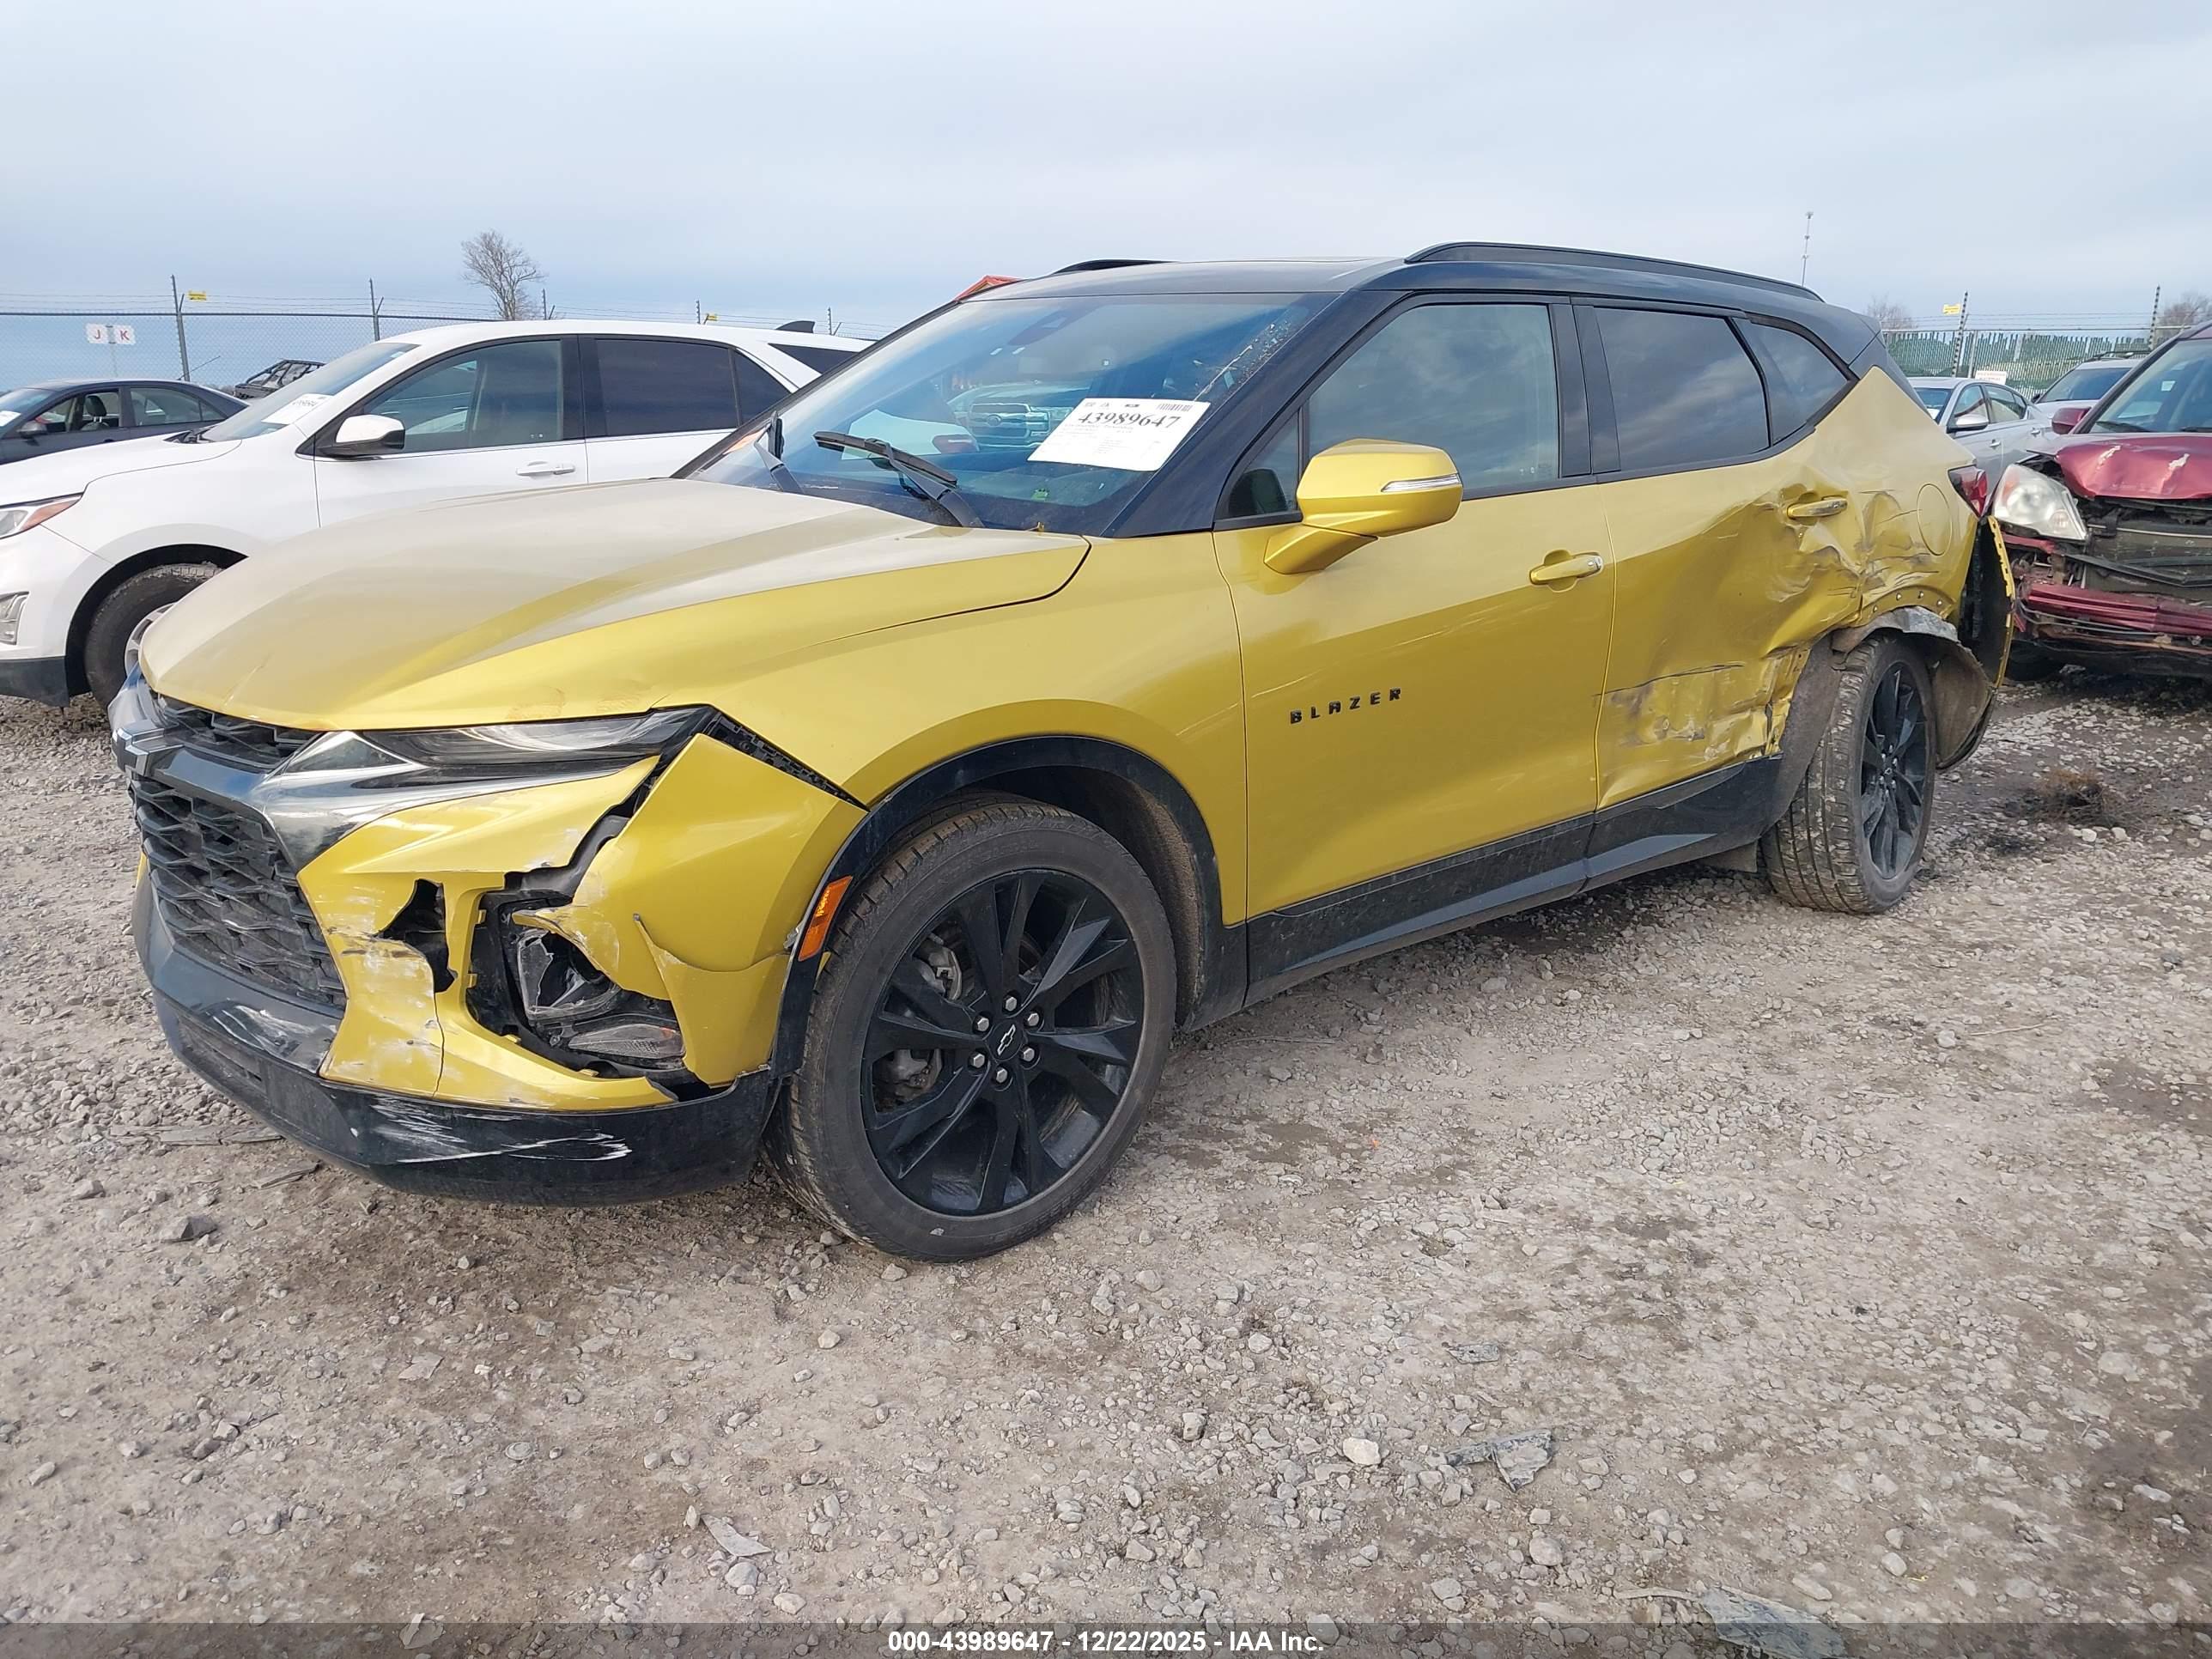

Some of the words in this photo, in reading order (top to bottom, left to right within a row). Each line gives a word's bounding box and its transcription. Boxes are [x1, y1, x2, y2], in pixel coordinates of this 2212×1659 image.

[94, 329, 101, 340] J
[119, 330, 130, 341] K
[1078, 411, 1182, 428] 43989647
[1290, 687, 1401, 725] BLAZER
